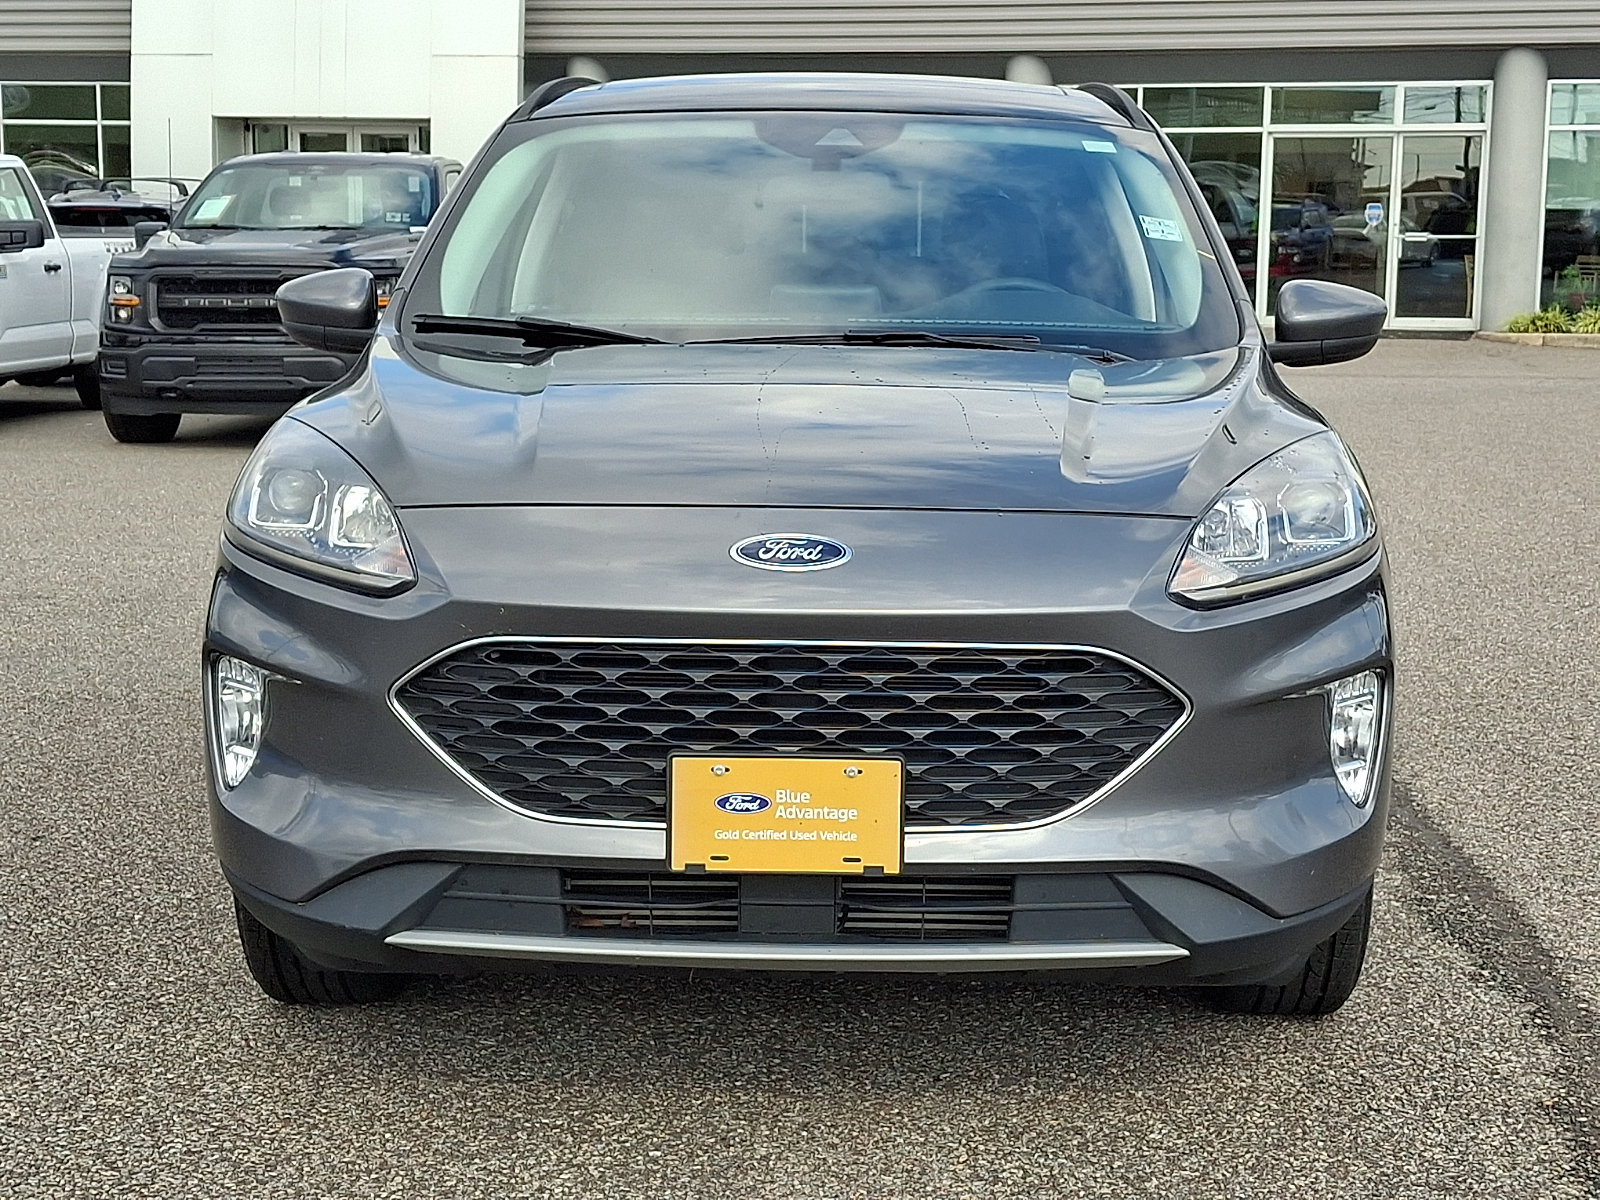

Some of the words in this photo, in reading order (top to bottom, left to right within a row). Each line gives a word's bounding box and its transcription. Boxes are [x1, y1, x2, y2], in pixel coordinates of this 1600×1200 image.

[758, 539, 822, 561] Ford
[725, 796, 760, 810] Ford
[775, 789, 811, 804] Blue
[775, 805, 858, 822] Advantage
[714, 829, 740, 840] Gold
[742, 829, 787, 840] Certified
[789, 830, 818, 840] Used
[819, 831, 858, 842] Vehicle
